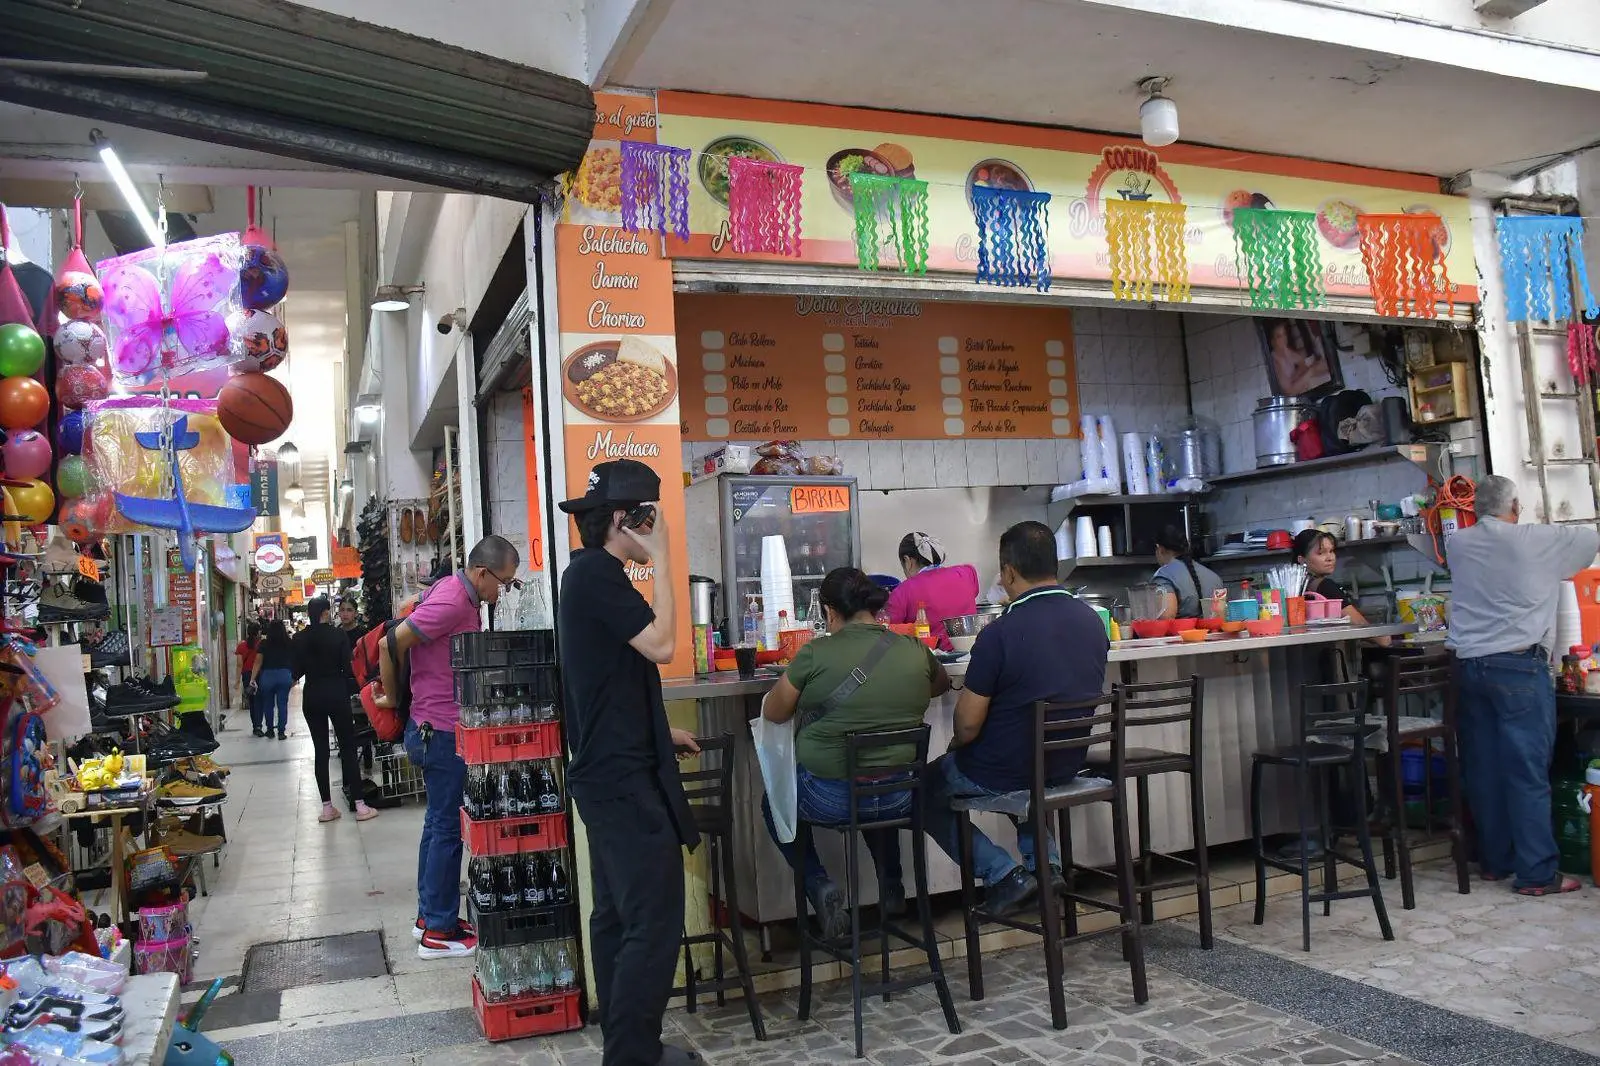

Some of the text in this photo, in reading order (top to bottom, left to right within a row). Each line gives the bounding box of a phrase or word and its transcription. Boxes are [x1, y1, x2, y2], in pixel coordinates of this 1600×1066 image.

[609, 105, 624, 128] al
[625, 112, 656, 135] gusto
[1104, 148, 1157, 174] COCINA
[579, 225, 649, 256] Salchicha
[592, 261, 639, 290] Jamón
[588, 300, 645, 328] Chorizo
[730, 355, 765, 368] Machaca
[762, 376, 782, 390] Mole
[857, 377, 891, 392] Enchiladas
[733, 397, 762, 413] Cazuela
[774, 397, 788, 412] Res
[858, 398, 892, 413] Enchiladas
[762, 423, 771, 433] de
[773, 419, 797, 433] Puerco
[1004, 419, 1016, 433] Res
[587, 430, 660, 459] Machaca
[259, 462, 271, 515] MERCERIA
[795, 488, 845, 511] BIRRIA
